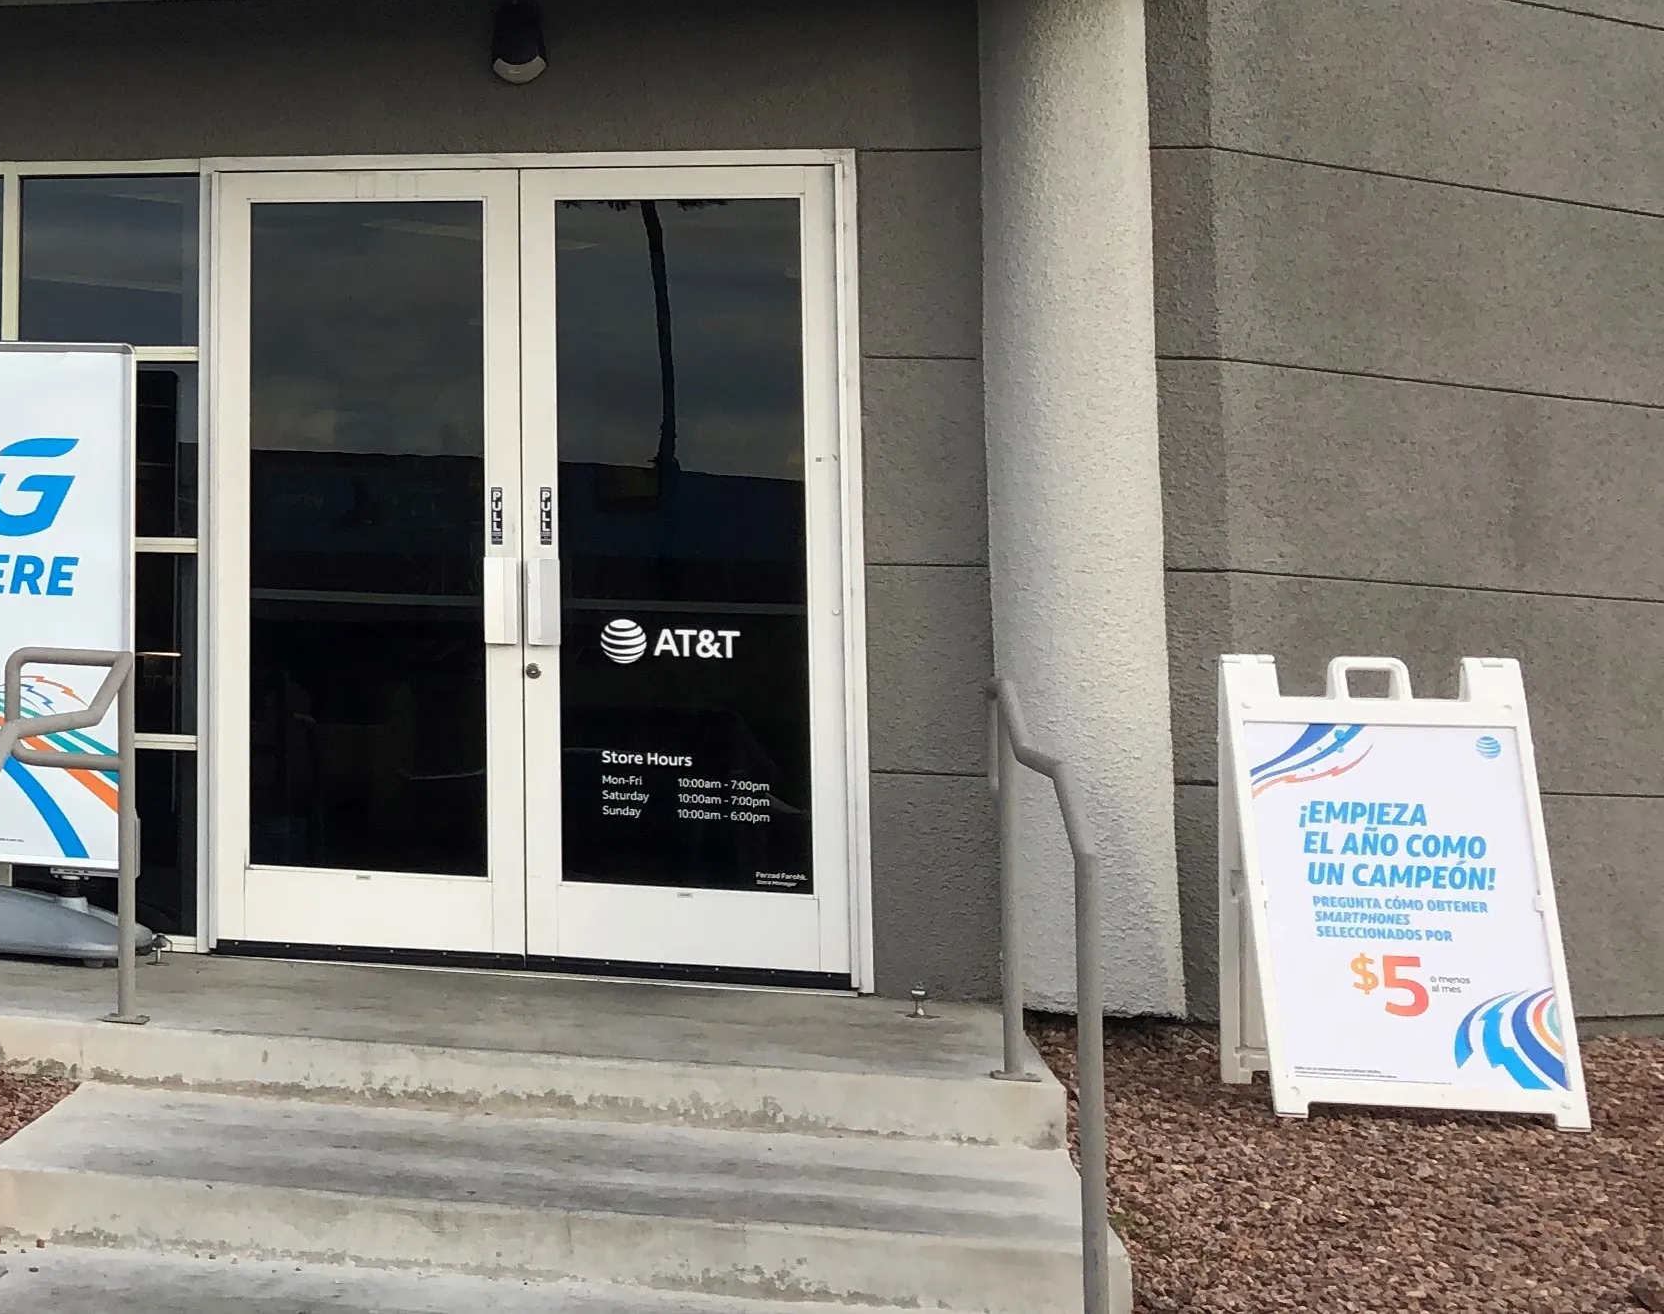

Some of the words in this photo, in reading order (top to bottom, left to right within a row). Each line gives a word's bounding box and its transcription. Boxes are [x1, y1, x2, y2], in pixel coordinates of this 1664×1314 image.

[491, 491, 502, 532] PULL
[541, 491, 551, 532] PULL
[653, 628, 741, 659] AT&T
[601, 750, 643, 765] Store
[647, 752, 693, 767] Hours
[602, 775, 643, 786] Mon-Fri
[677, 778, 722, 789] 10:00am
[731, 780, 770, 792] 7:00pm
[602, 790, 650, 803] Saturday
[678, 793, 722, 805] 10:00am
[731, 796, 770, 808] 7:00pm
[602, 805, 642, 819] Sunday
[677, 809, 722, 821] 10:00am
[731, 811, 770, 824] 6:00pm
[1299, 800, 1427, 828] ¡EMPIEZA
[1303, 831, 1334, 855] EL
[1340, 826, 1399, 857] AÑO
[1405, 834, 1486, 860] COMO
[1307, 862, 1345, 886] UN
[1352, 860, 1496, 891] CAMPEÓN!
[1312, 895, 1382, 910] PREGUNTA
[1385, 896, 1424, 911] CÓMO
[1427, 899, 1489, 913] OBTENER
[1315, 911, 1411, 926] SMARTPHONES
[1316, 926, 1423, 941] SELECCIONADOS
[1426, 930, 1453, 942] POR
[1350, 952, 1429, 1017] $5
